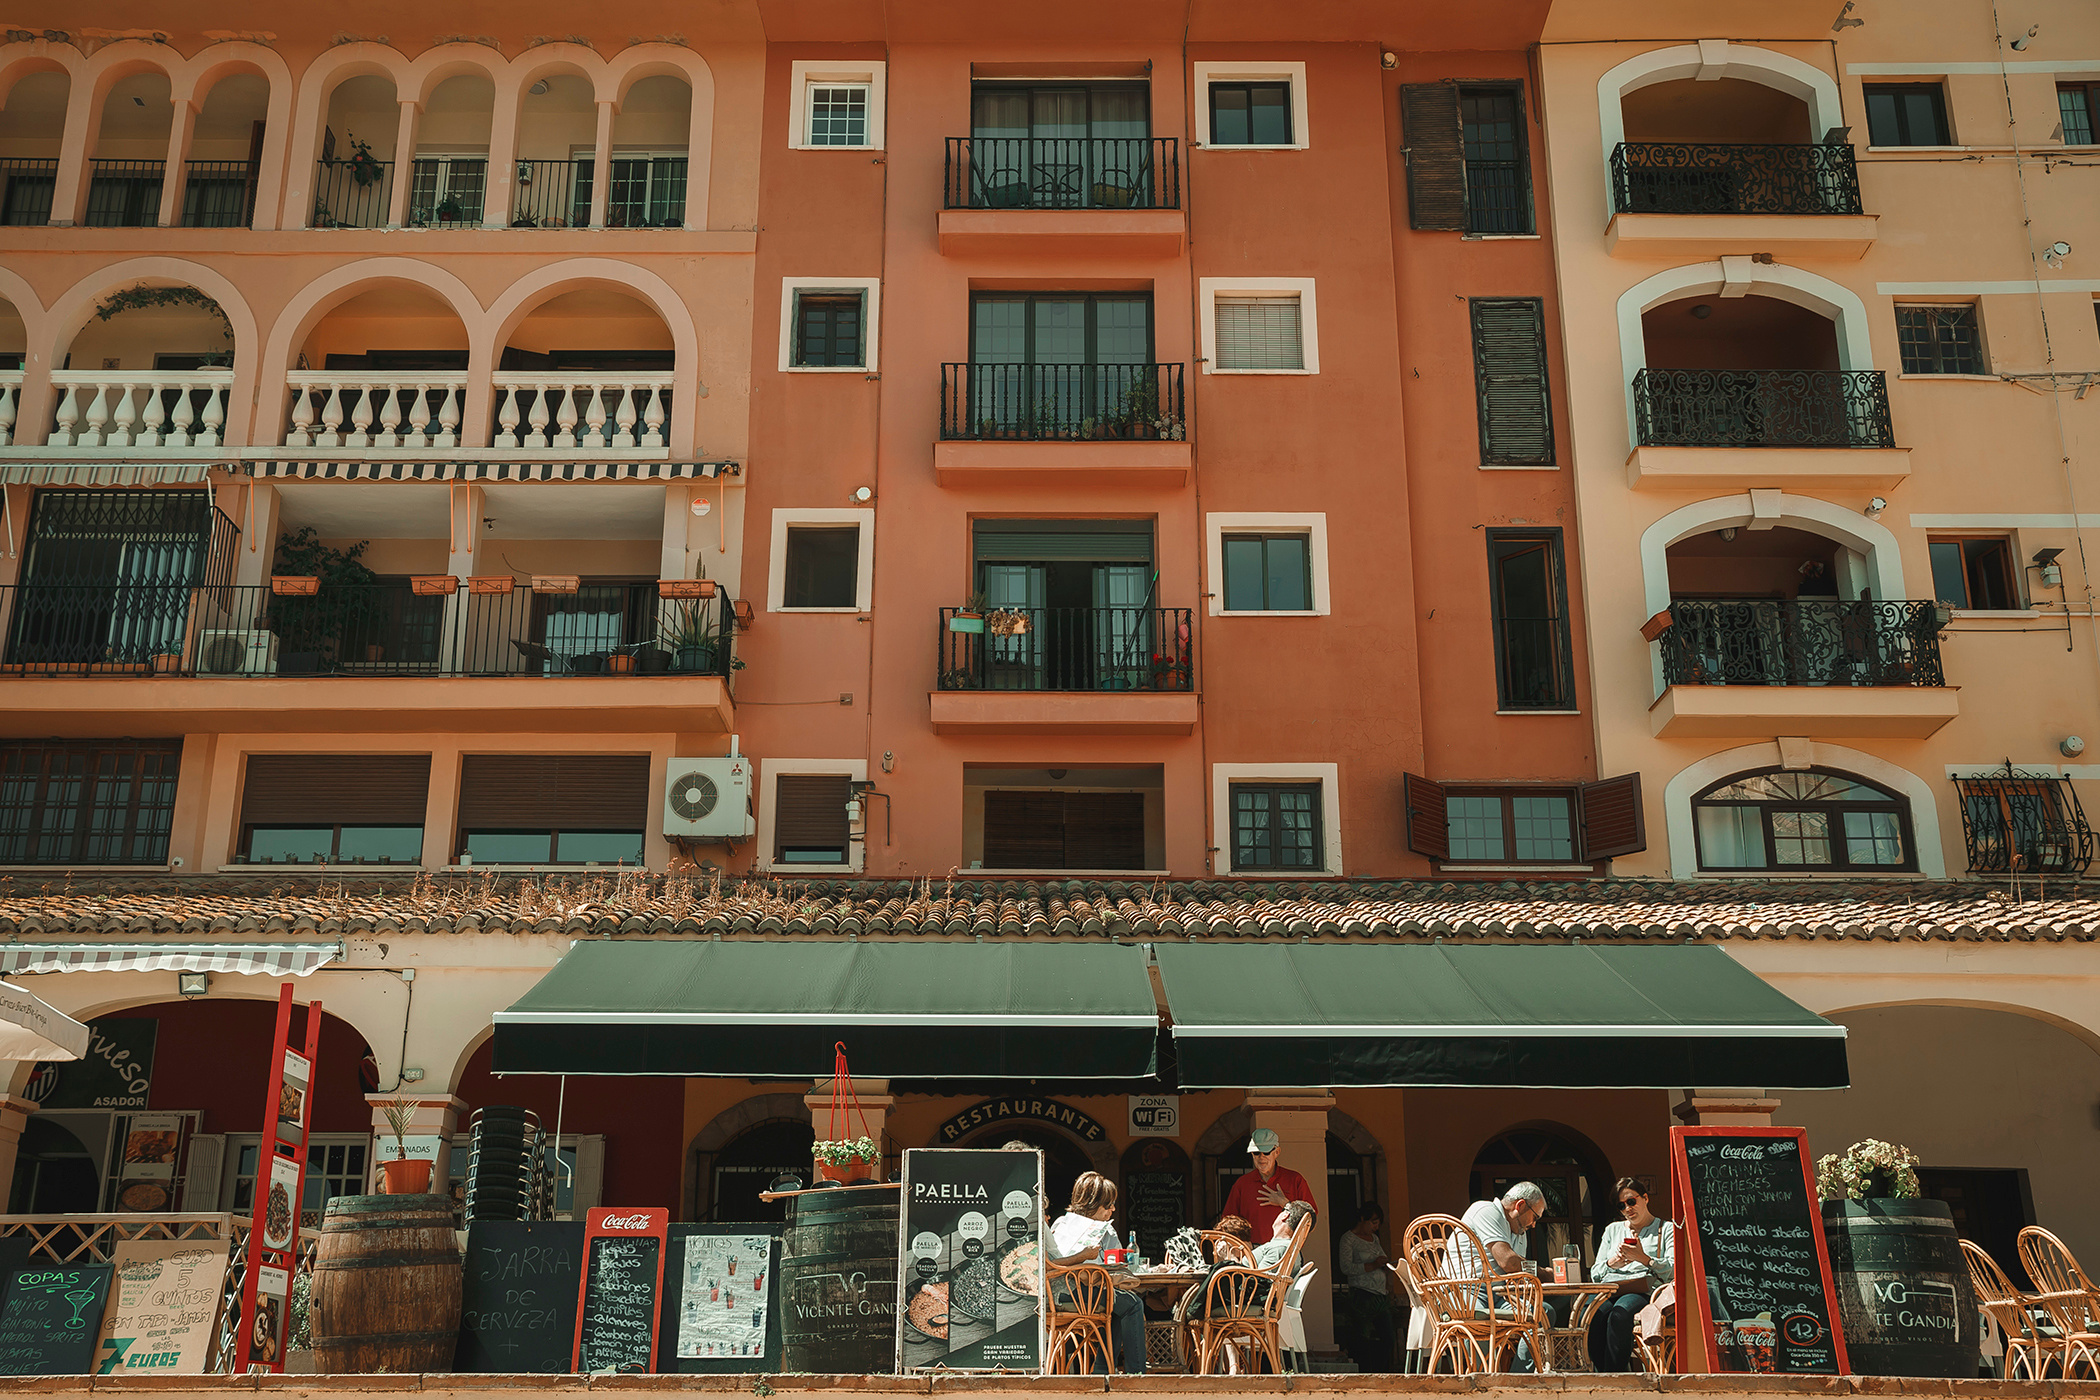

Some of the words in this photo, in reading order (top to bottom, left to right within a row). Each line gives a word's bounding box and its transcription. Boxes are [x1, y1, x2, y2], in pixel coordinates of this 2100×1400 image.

[93, 1096, 145, 1106] ASADOR
[1140, 1098, 1168, 1106] ZONA
[943, 1100, 1101, 1140] RESTAURANTE
[385, 1146, 431, 1154] EMNADAS
[1720, 1144, 1765, 1160] Coca-Cola
[915, 1183, 989, 1198] PAELLA
[601, 1214, 653, 1230] Coca-Cola
[170, 1248, 214, 1266] CUBO
[481, 1246, 572, 1281] JARRA
[18, 1272, 80, 1284] COPAS
[176, 1269, 194, 1288] 5
[505, 1289, 536, 1306] DE
[795, 1303, 854, 1319] VICENTE
[858, 1300, 899, 1316] GAND
[104, 1316, 133, 1330] CON
[462, 1308, 557, 1331] CERVEZA
[1898, 1310, 1957, 1330] GANDIA
[1736, 1330, 1776, 1347] Coca-Cola
[96, 1337, 137, 1374] 7
[126, 1352, 182, 1368] EUROS
